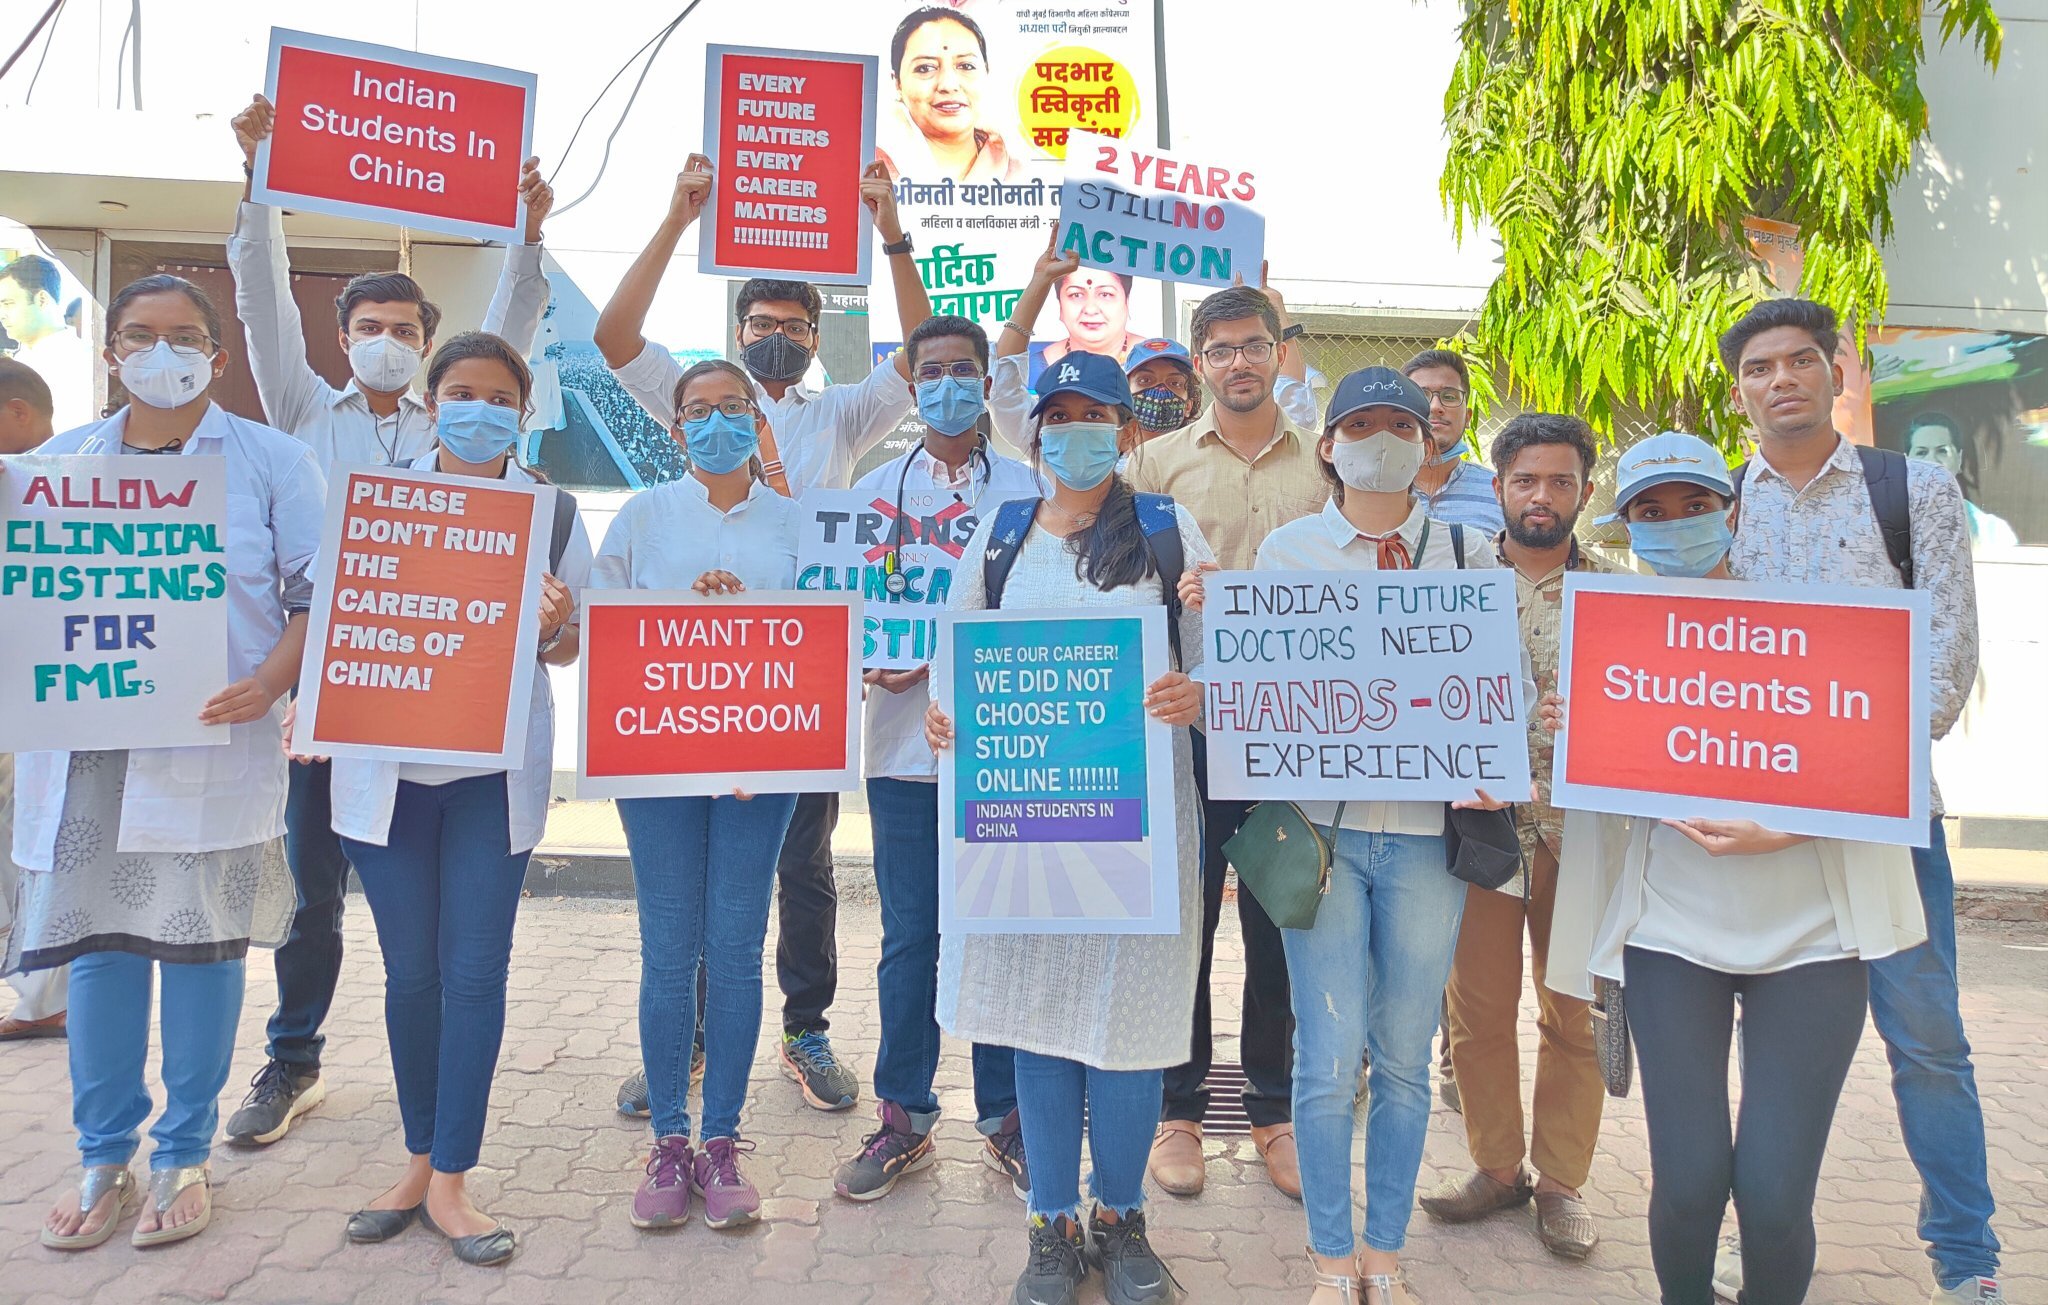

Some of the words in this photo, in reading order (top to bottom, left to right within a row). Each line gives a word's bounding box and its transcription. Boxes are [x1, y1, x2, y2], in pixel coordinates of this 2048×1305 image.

[739, 73, 806, 94] EVERY
[1035, 62, 1114, 83] पदभार
[353, 70, 456, 113] Indian
[1030, 86, 1120, 122] स्विकृती
[738, 98, 815, 121] FUTURE
[301, 103, 456, 153] Students
[467, 131, 496, 160] In
[737, 124, 829, 147] MATTERS
[349, 153, 446, 193] China
[736, 150, 803, 171] EVERY
[1095, 146, 1119, 174] 2
[1131, 151, 1256, 201] YEARS
[735, 176, 817, 198] CAREER
[959, 177, 1045, 206] यशोमती
[734, 201, 827, 224] MATTERS
[920, 214, 954, 229] महिला
[955, 217, 963, 229] व
[965, 214, 1017, 229] बालविकास
[1019, 215, 1040, 229] मंत्री
[1061, 221, 1232, 281] ACTION
[22, 475, 198, 510] ALLOW
[352, 481, 467, 516] PLEASE
[910, 496, 934, 507] NO
[6, 520, 227, 557] CLINICAL
[347, 517, 439, 548] DON'T
[443, 527, 517, 556] RUIN
[342, 551, 400, 580] THE
[2, 562, 227, 602] POSTINGS
[796, 563, 952, 604] CLINCA
[1223, 579, 1358, 616] INDIA'S
[1377, 582, 1499, 615] FUTURE
[337, 588, 460, 621] CAREER
[466, 599, 507, 625] OF
[64, 614, 157, 651] FOR
[331, 624, 415, 653] FMGs
[423, 632, 464, 657] OF
[639, 619, 645, 647] I
[657, 619, 753, 647] WANT
[762, 618, 804, 646] TO
[1214, 625, 1356, 663] DOCTORS
[1381, 624, 1473, 656] NEED
[1666, 612, 1807, 657] Indian
[974, 648, 1013, 664] SAVE
[1017, 647, 1049, 663] OUR
[1053, 645, 1119, 662] CAREER!
[326, 660, 433, 691] CHINA!
[643, 662, 754, 691] STUDY
[764, 661, 795, 689] IN
[975, 670, 1012, 694] WE
[1018, 669, 1059, 693] DID
[1066, 668, 1113, 692] NOT
[1603, 664, 1812, 716] Students
[1829, 680, 1870, 721] In
[615, 704, 820, 736] CLASSROOM
[975, 701, 1070, 727] CHOOSE
[1076, 701, 1106, 725] TO
[975, 735, 1050, 760] STUDY
[1245, 743, 1506, 780] EXPERIENCE
[1666, 725, 1799, 774] China
[976, 768, 1062, 793] ONLINE
[976, 804, 1023, 819] INDIAN
[1026, 803, 1096, 818] STUDENTS
[1100, 803, 1114, 818] IN
[976, 823, 1018, 838] CHINA
